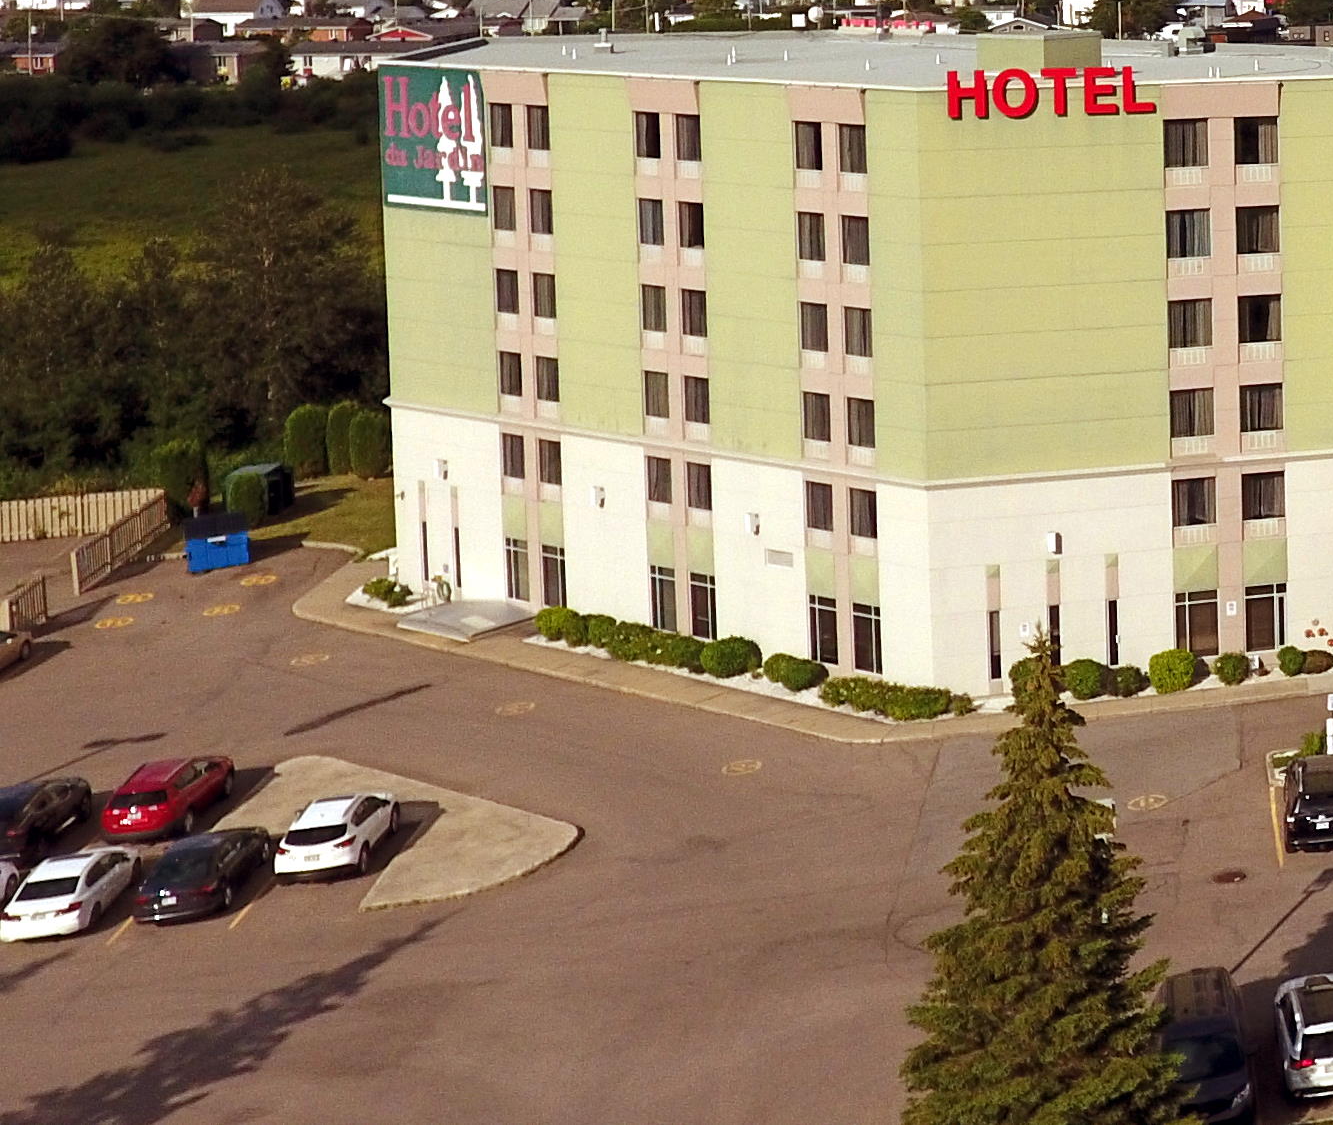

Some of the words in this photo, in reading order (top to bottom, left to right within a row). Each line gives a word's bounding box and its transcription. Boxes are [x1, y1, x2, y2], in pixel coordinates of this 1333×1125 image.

[383, 75, 475, 142] Hotel
[946, 66, 1157, 119] HOTEL
[385, 142, 408, 166] du
[414, 145, 484, 172] Jardin
